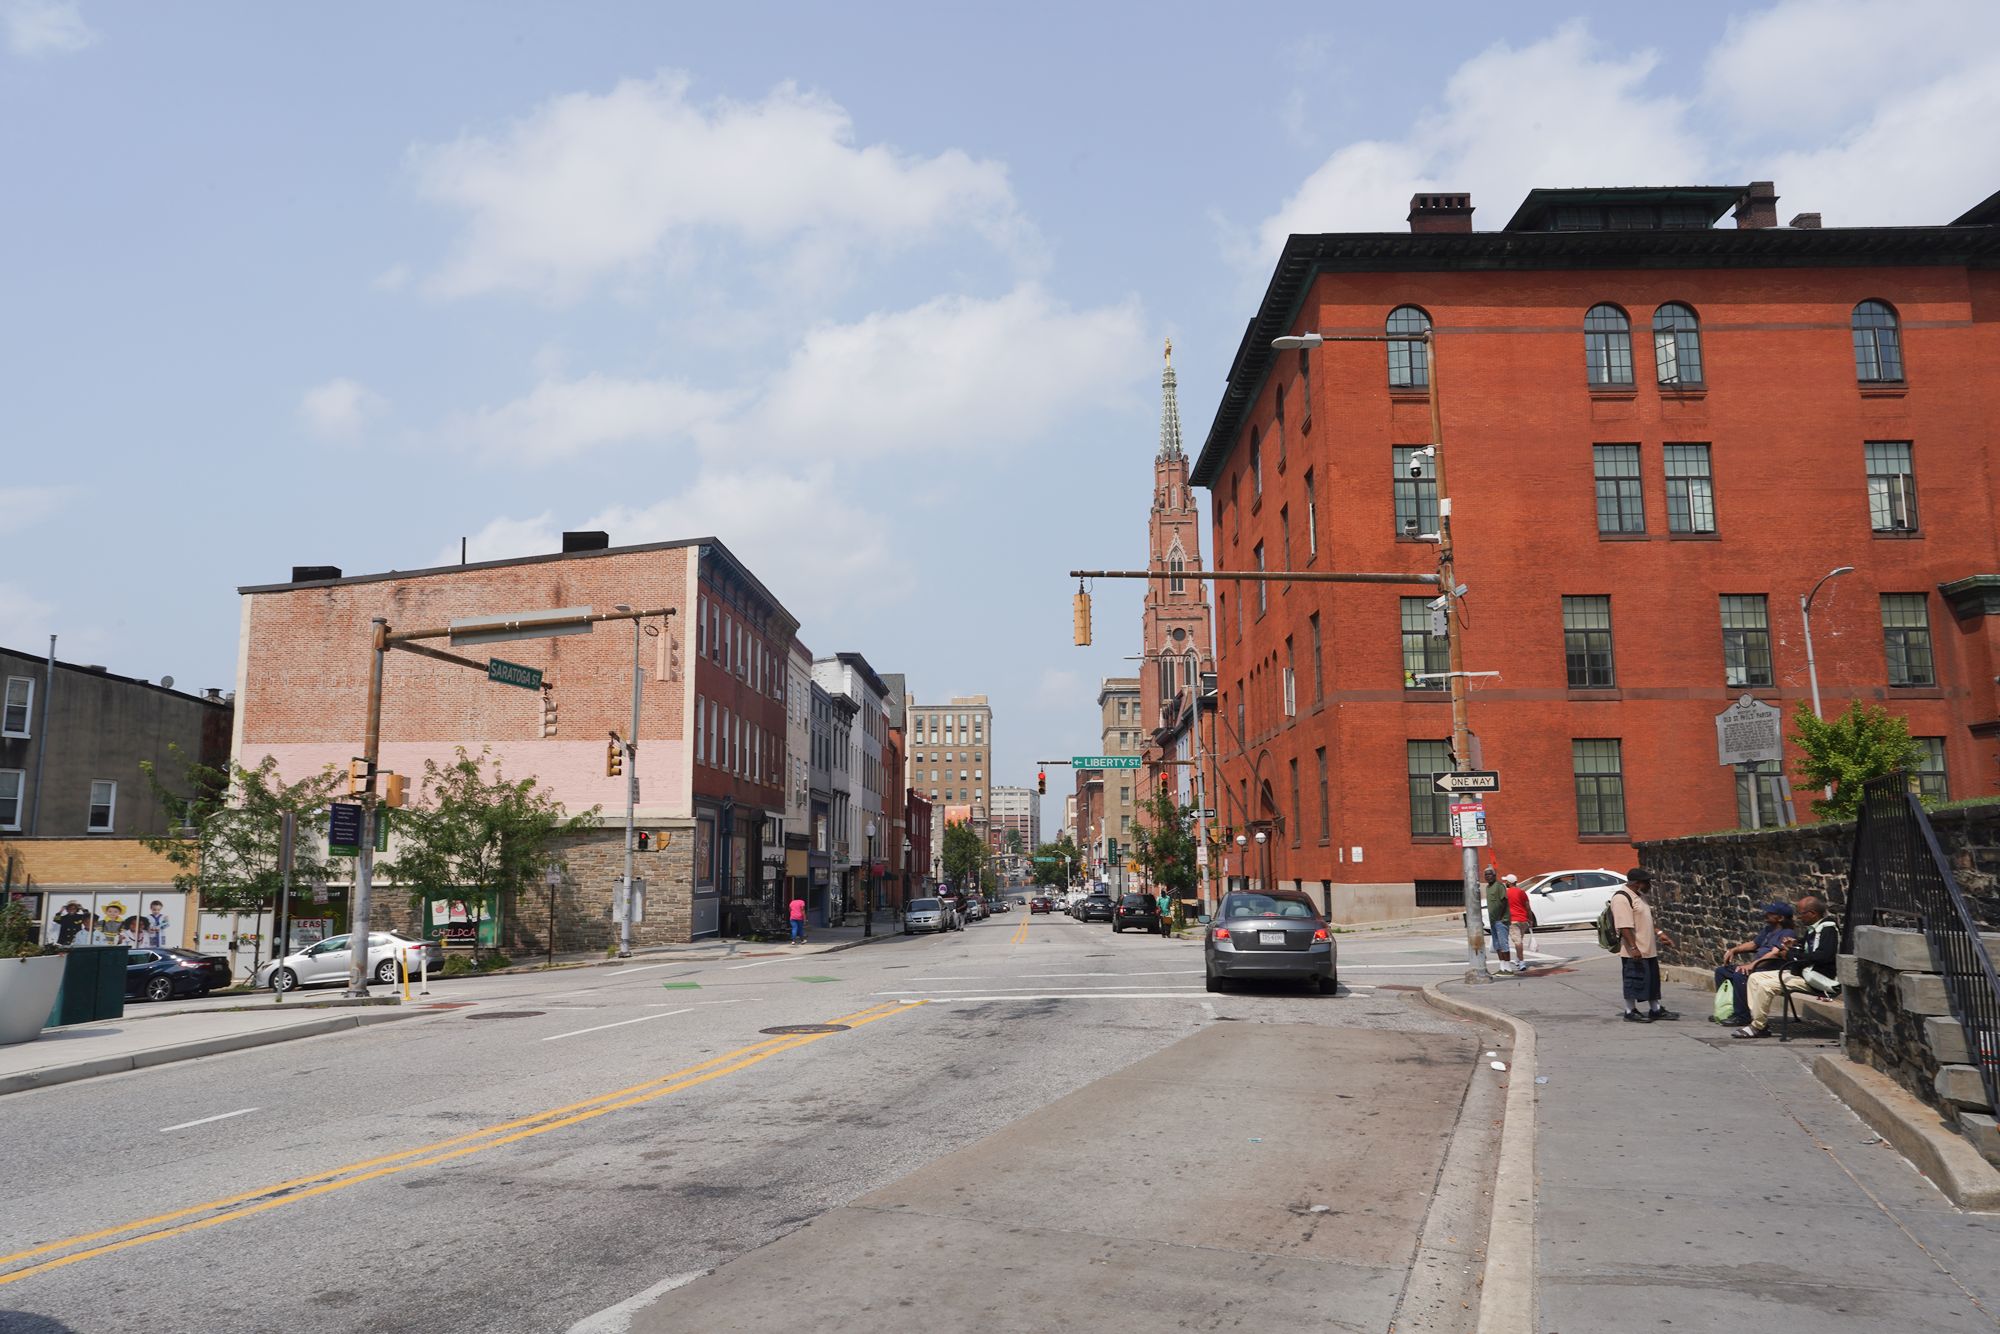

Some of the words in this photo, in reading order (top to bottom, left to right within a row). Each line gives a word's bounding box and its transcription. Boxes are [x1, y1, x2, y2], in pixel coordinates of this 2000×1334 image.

[491, 662, 530, 685] SARATOGA
[1084, 758, 1128, 766] LIBERTY
[1452, 778, 1470, 786] ONE
[1472, 777, 1492, 786] WAY
